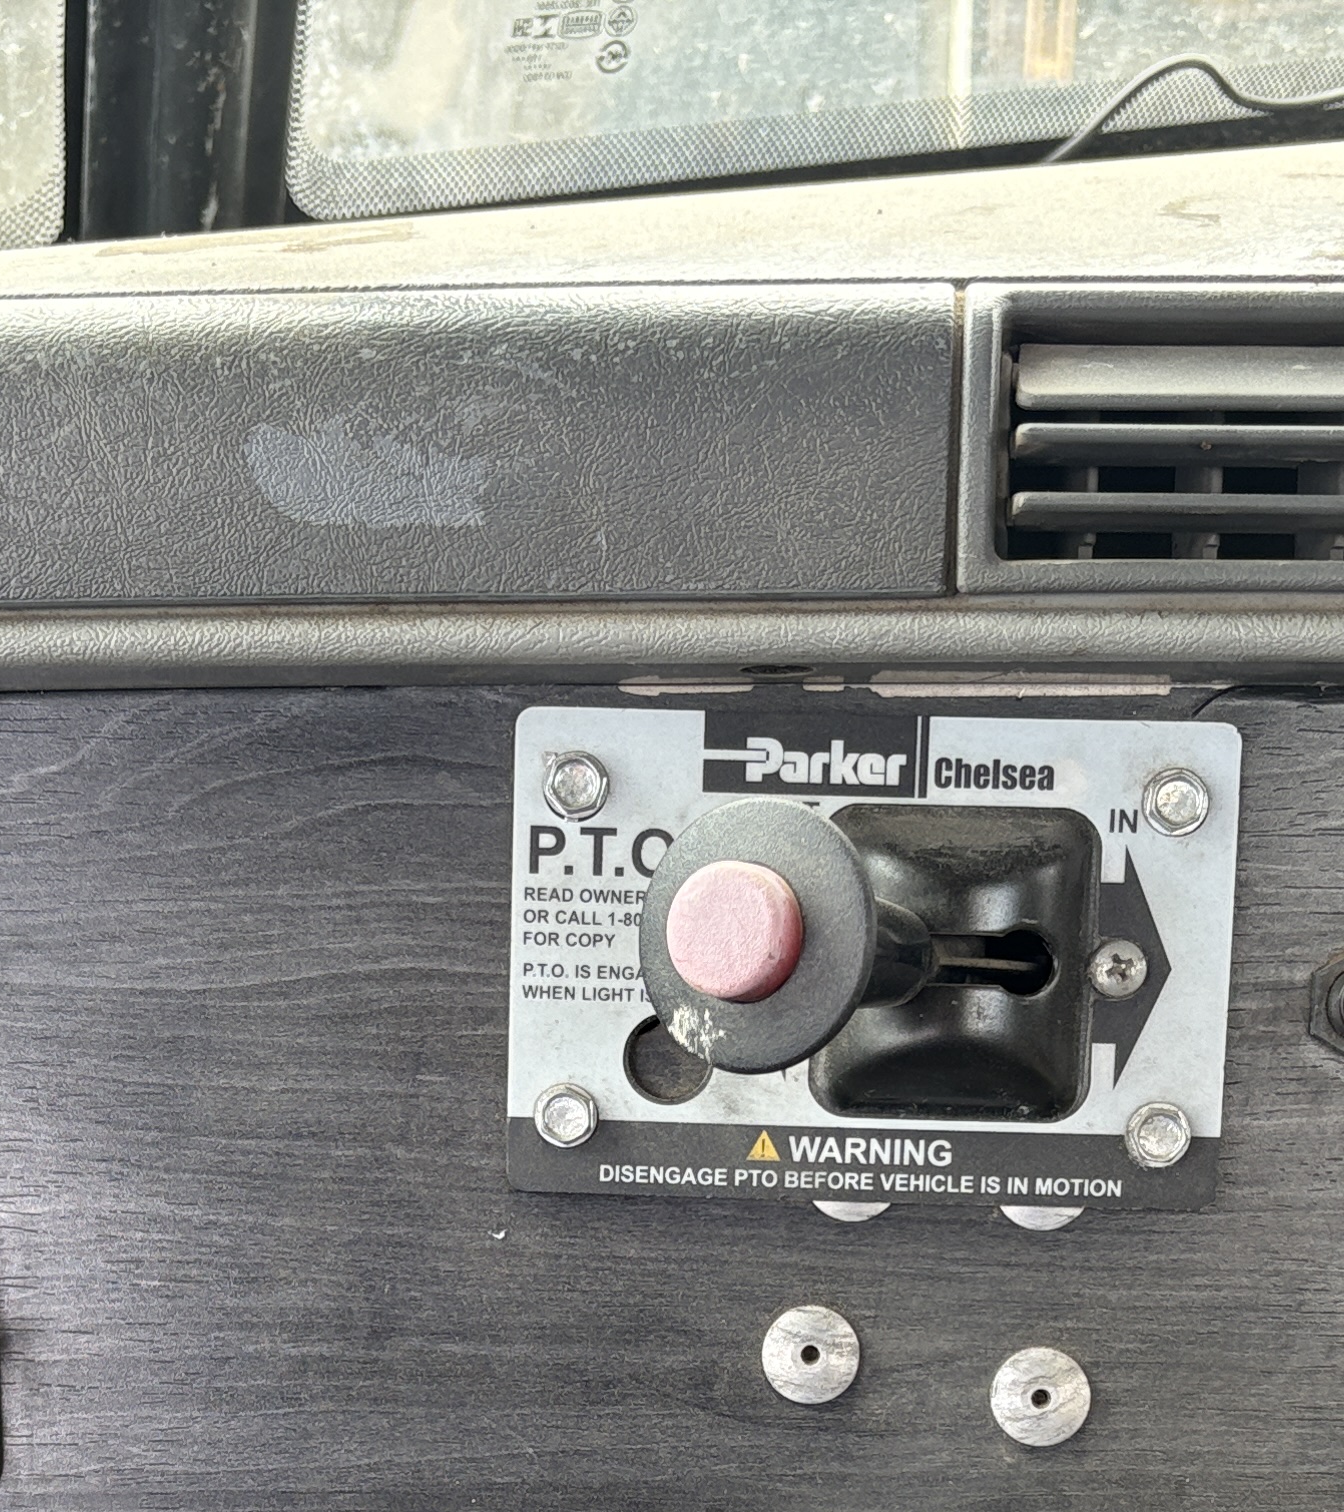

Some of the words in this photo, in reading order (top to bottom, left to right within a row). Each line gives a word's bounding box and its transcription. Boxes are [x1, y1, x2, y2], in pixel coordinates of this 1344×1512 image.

[745, 736, 907, 787] Parker
[933, 757, 1055, 791] Chelsea
[1108, 808, 1139, 833] IN
[524, 887, 574, 903] READ
[523, 909, 549, 924] OR
[555, 910, 602, 926] CALL
[523, 931, 560, 946] FOR
[565, 933, 616, 948] COPY
[523, 963, 569, 979] P.T.O.
[575, 964, 591, 979] IS
[522, 985, 576, 1000] WHEN
[582, 986, 635, 1002] LIGHT
[789, 1136, 953, 1167] WARNING
[599, 1163, 728, 1187] DISENGAGE
[734, 1169, 778, 1188] PTO
[783, 1171, 874, 1191] BEFORE
[879, 1173, 974, 1194] VEHICLE
[980, 1175, 1001, 1195] IS
[1006, 1176, 1029, 1195] IN
[1034, 1177, 1123, 1198] MOTION
